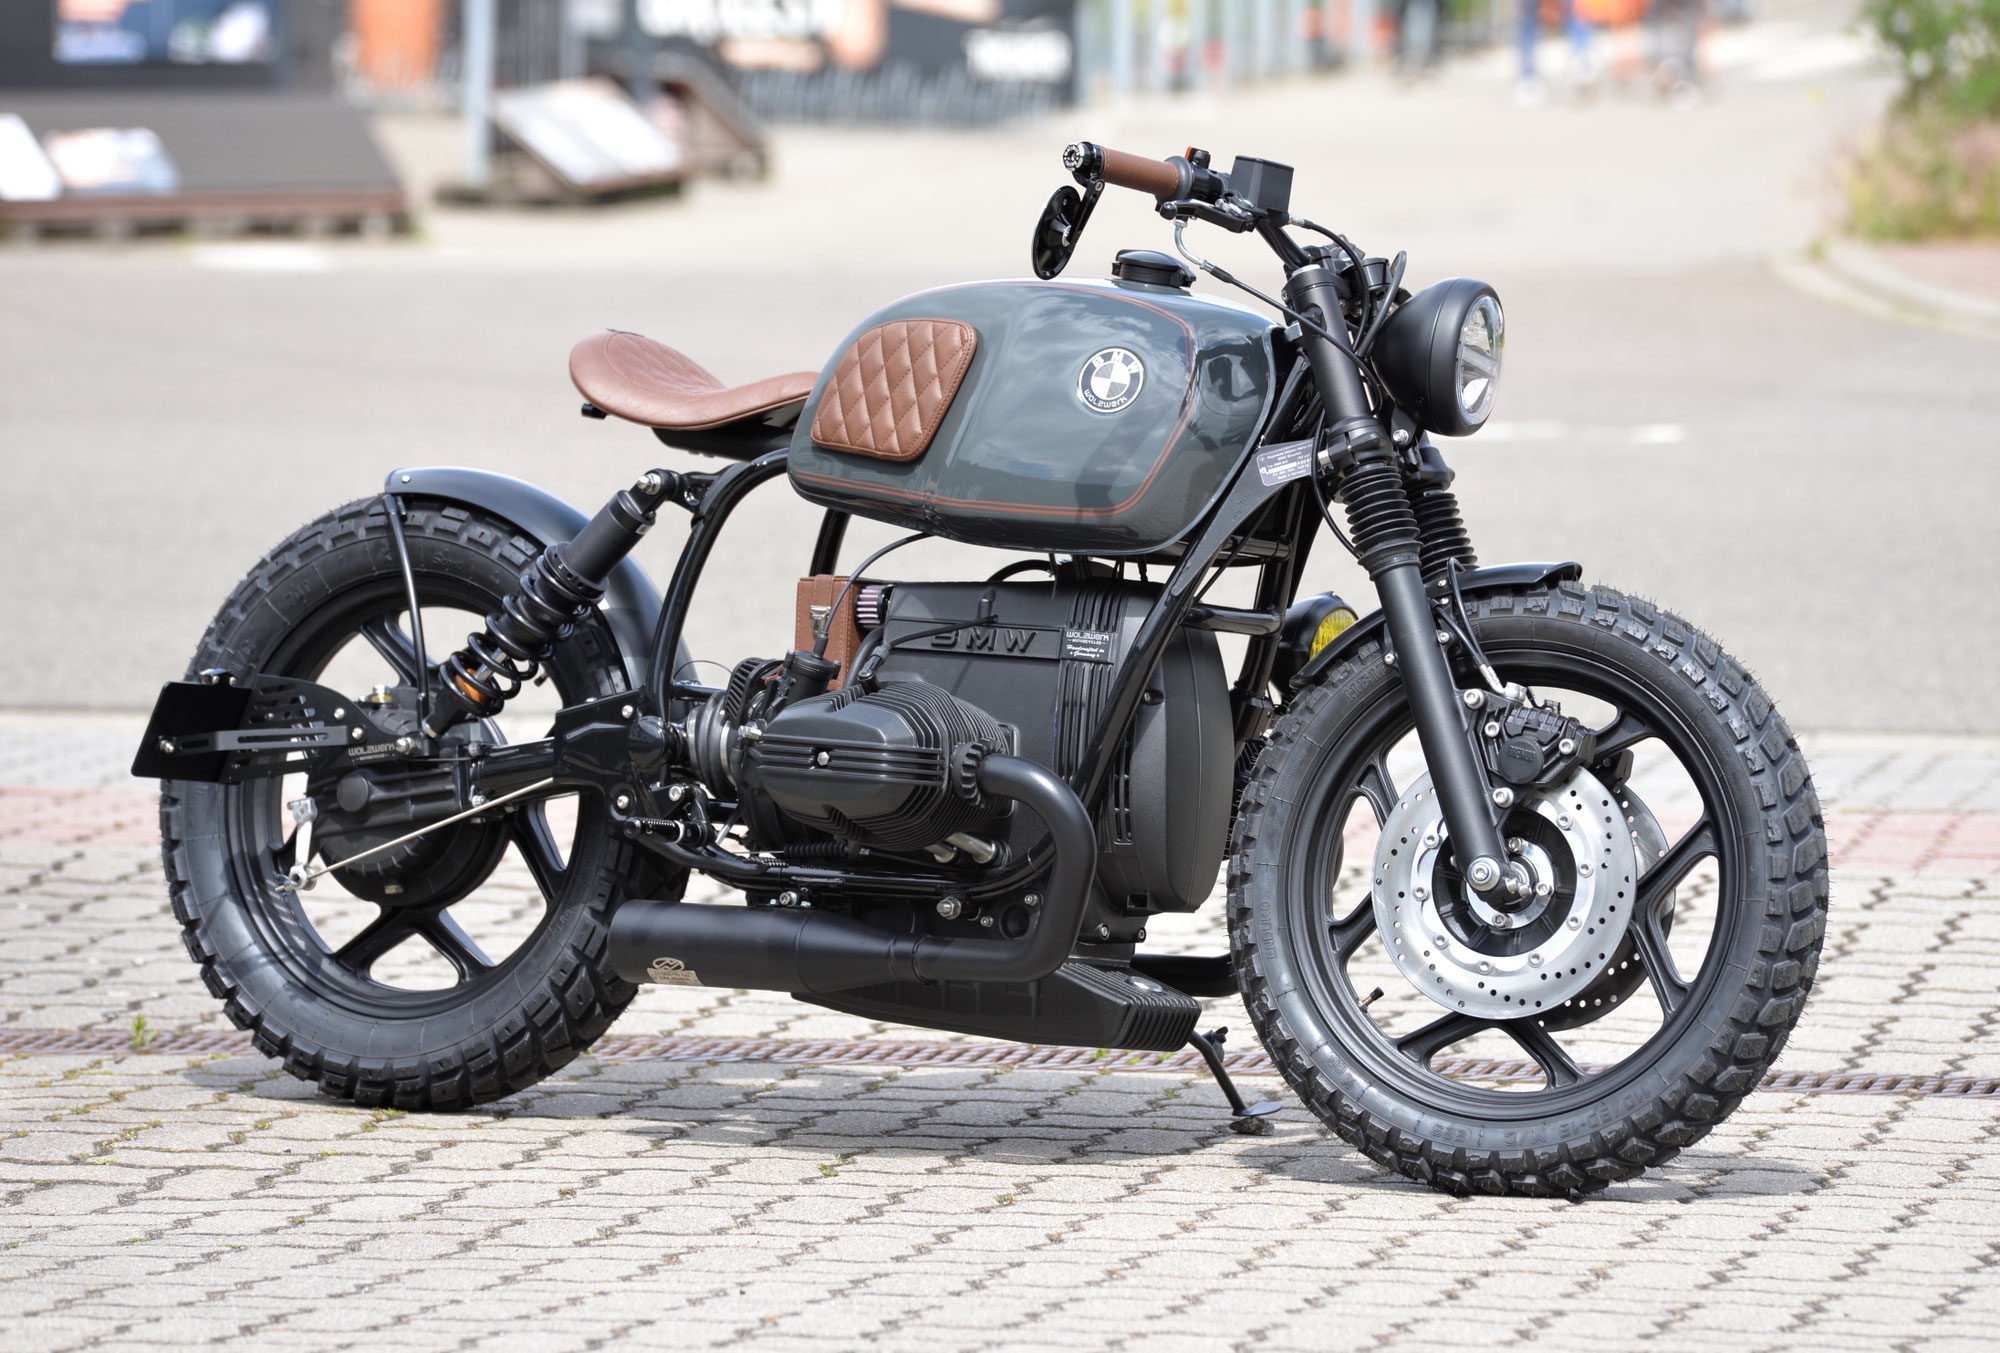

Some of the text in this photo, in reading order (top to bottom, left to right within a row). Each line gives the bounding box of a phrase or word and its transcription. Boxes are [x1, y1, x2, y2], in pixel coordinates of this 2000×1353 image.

[1092, 351, 1141, 374] BMW
[930, 628, 1039, 654] BMW
[1258, 899, 1278, 960] ENDURO
